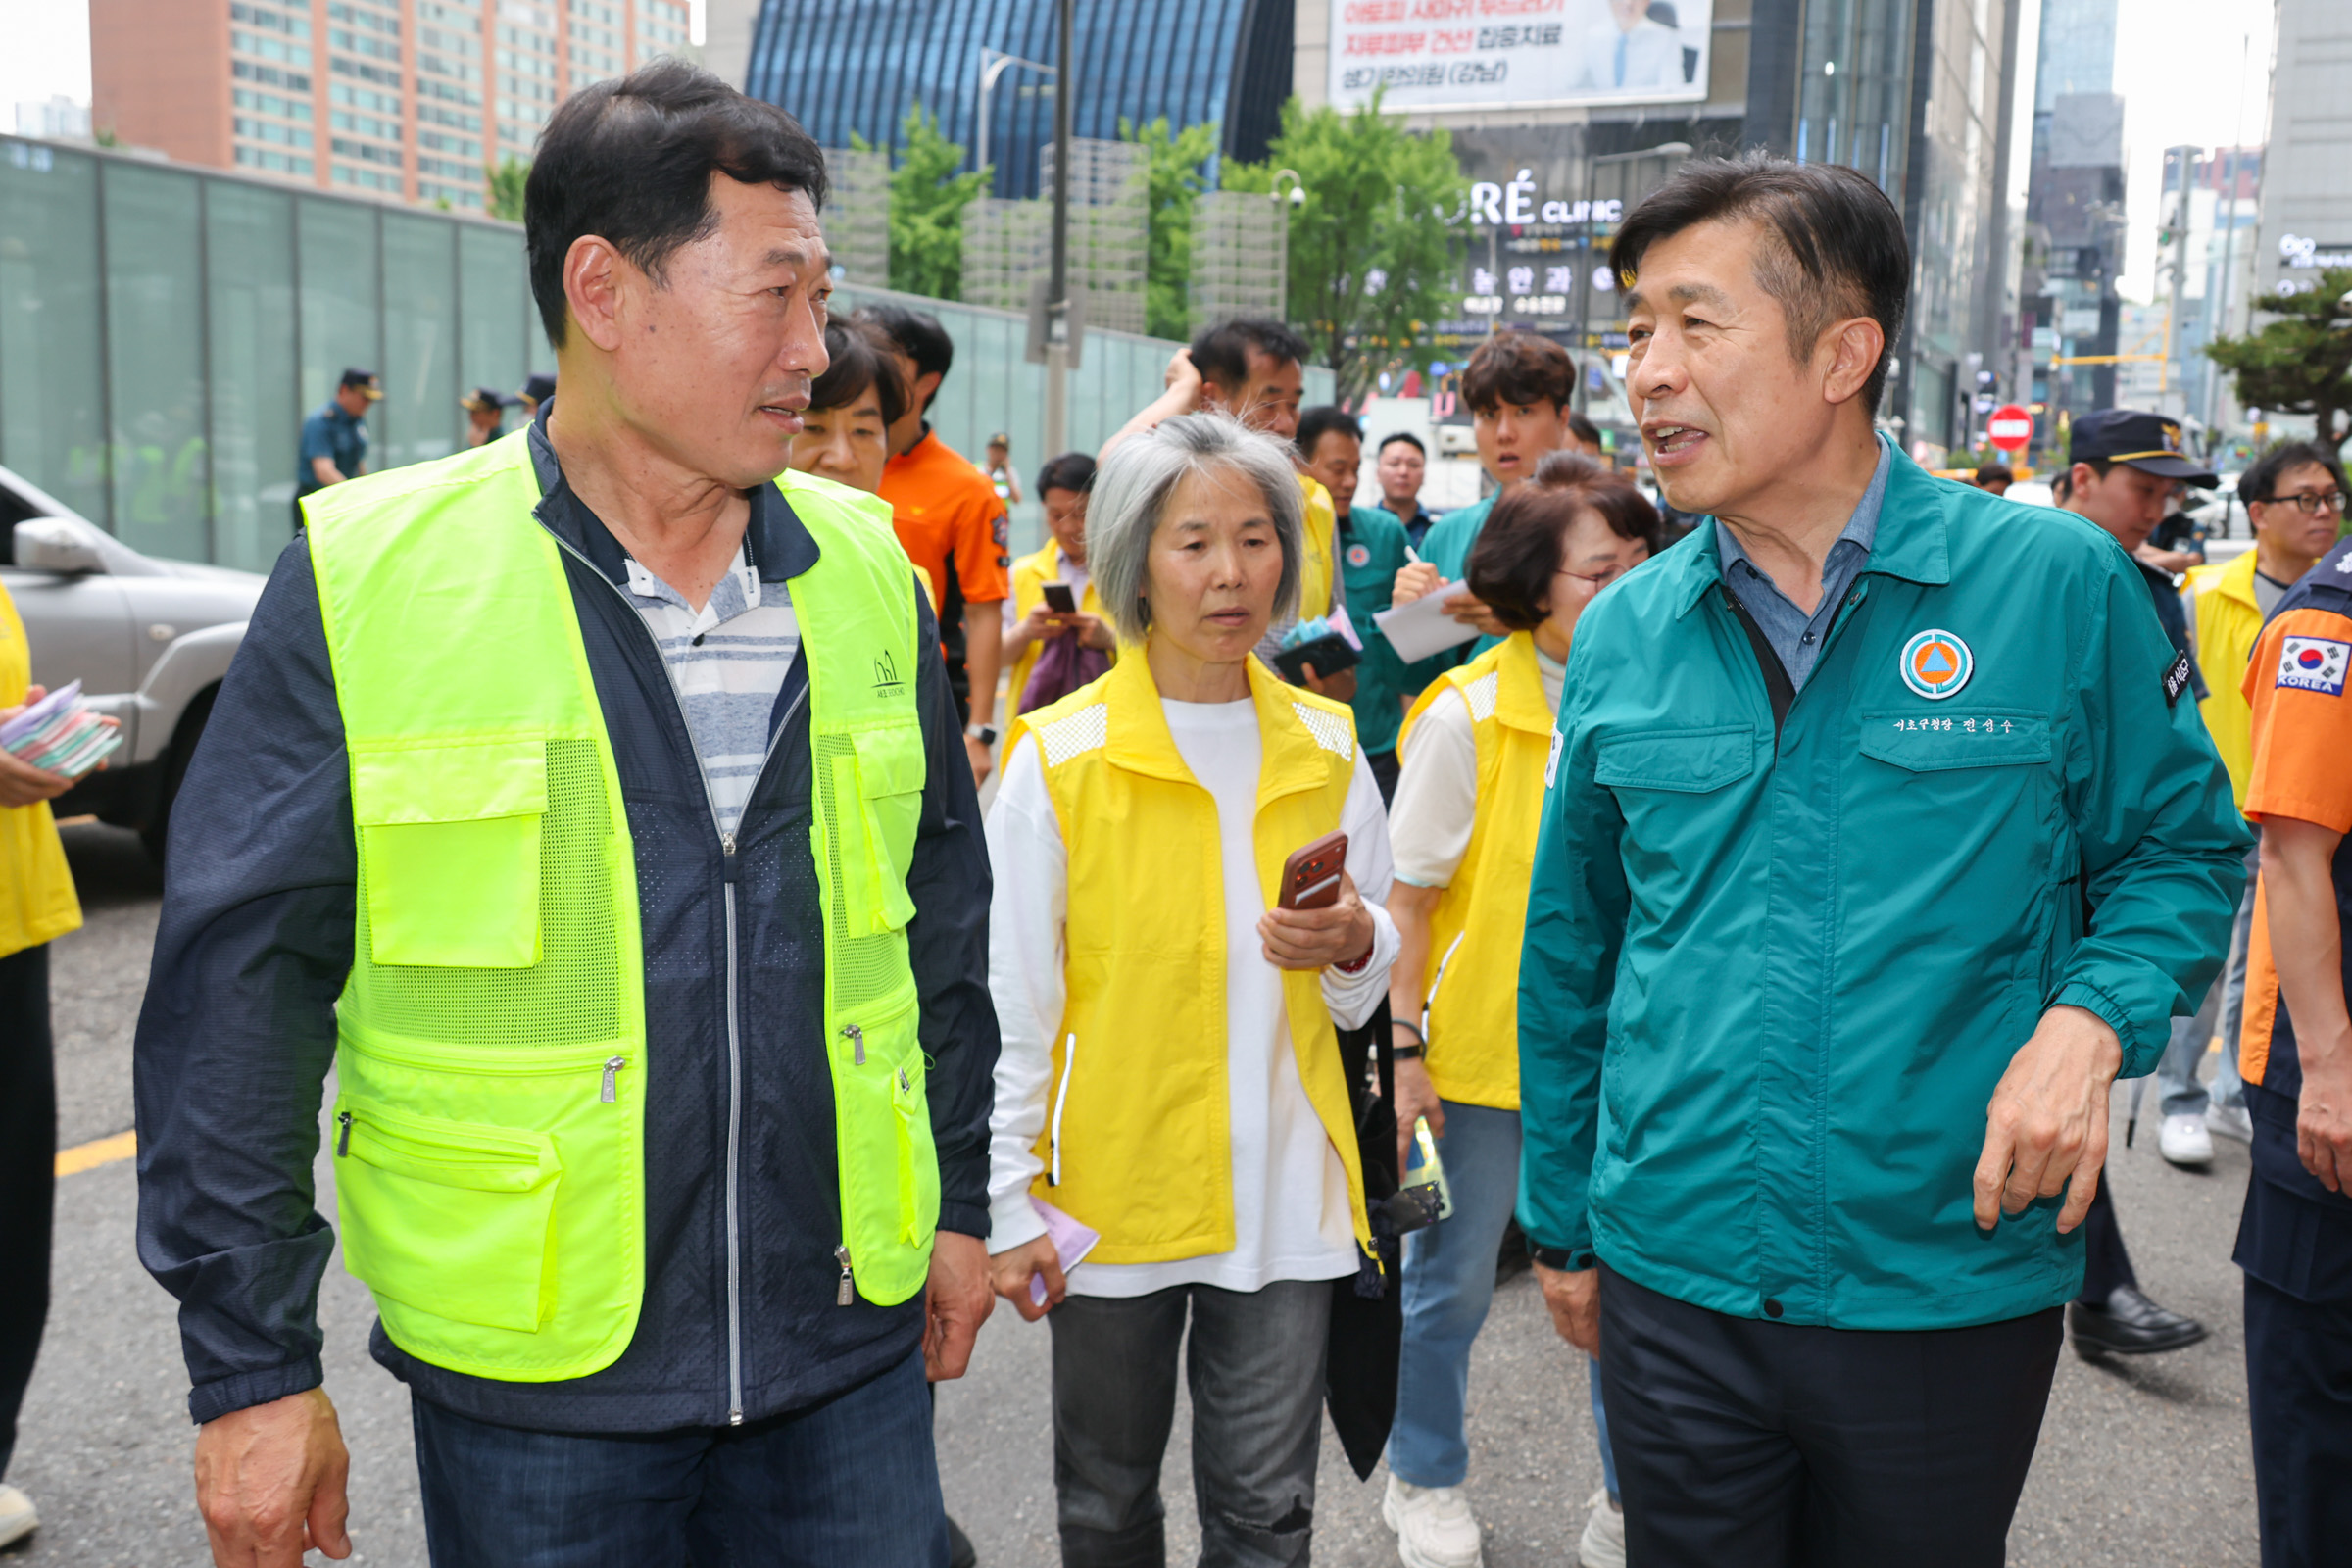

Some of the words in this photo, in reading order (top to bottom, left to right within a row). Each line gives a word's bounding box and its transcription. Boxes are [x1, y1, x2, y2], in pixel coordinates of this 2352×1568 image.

[1431, 28, 1474, 53] 건선
[1477, 23, 1563, 50] 집중치료
[1448, 58, 1508, 85] (강남)
[2278, 675, 2333, 692] KOREA
[1893, 717, 1953, 732] 서초구청장
